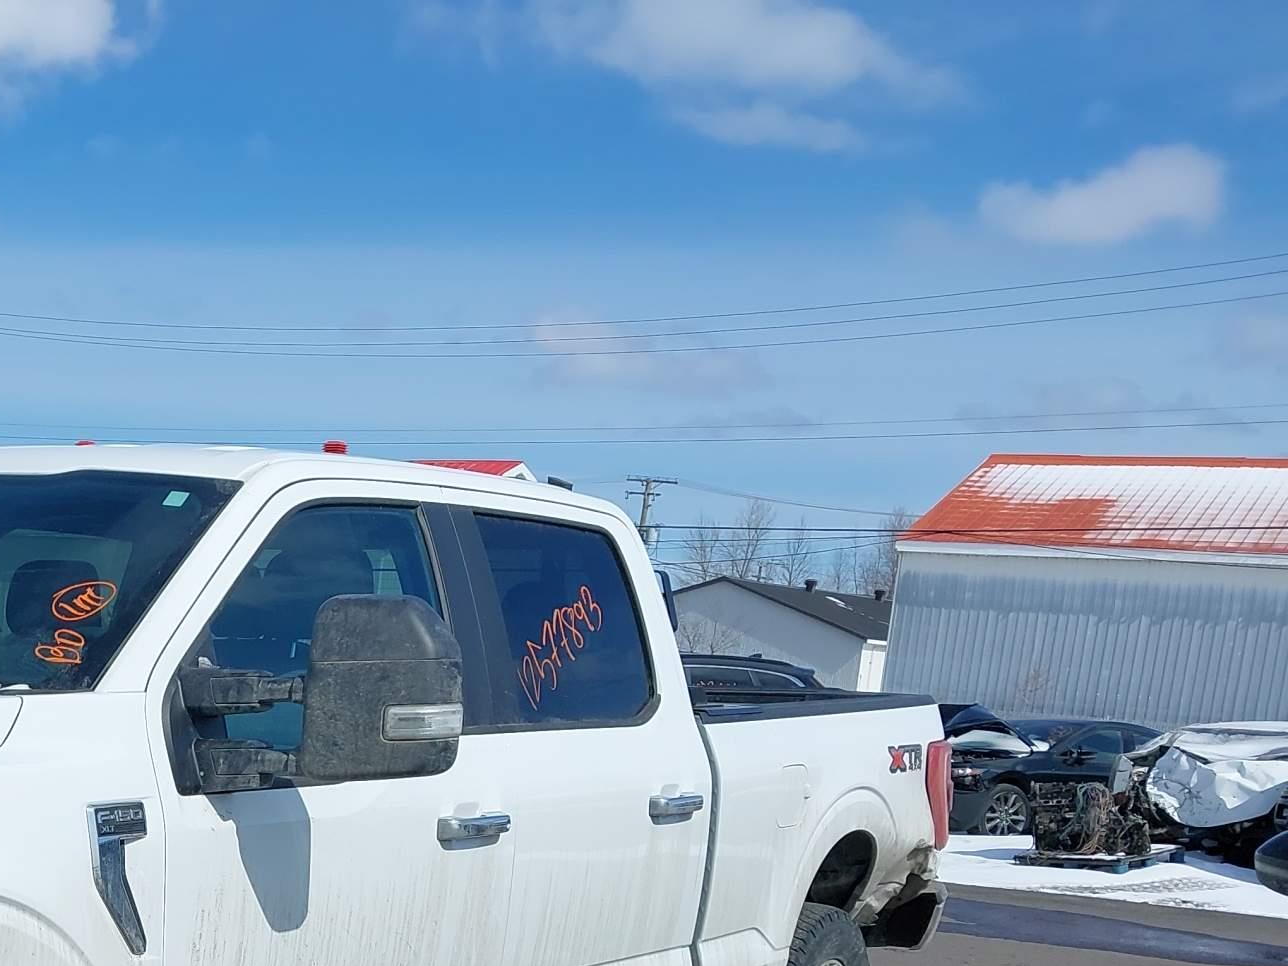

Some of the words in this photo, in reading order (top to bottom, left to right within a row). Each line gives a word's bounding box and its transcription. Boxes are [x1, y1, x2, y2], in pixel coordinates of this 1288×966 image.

[516, 585, 602, 711] 12577893
[887, 744, 922, 773] XTR
[97, 809, 143, 823] F-150
